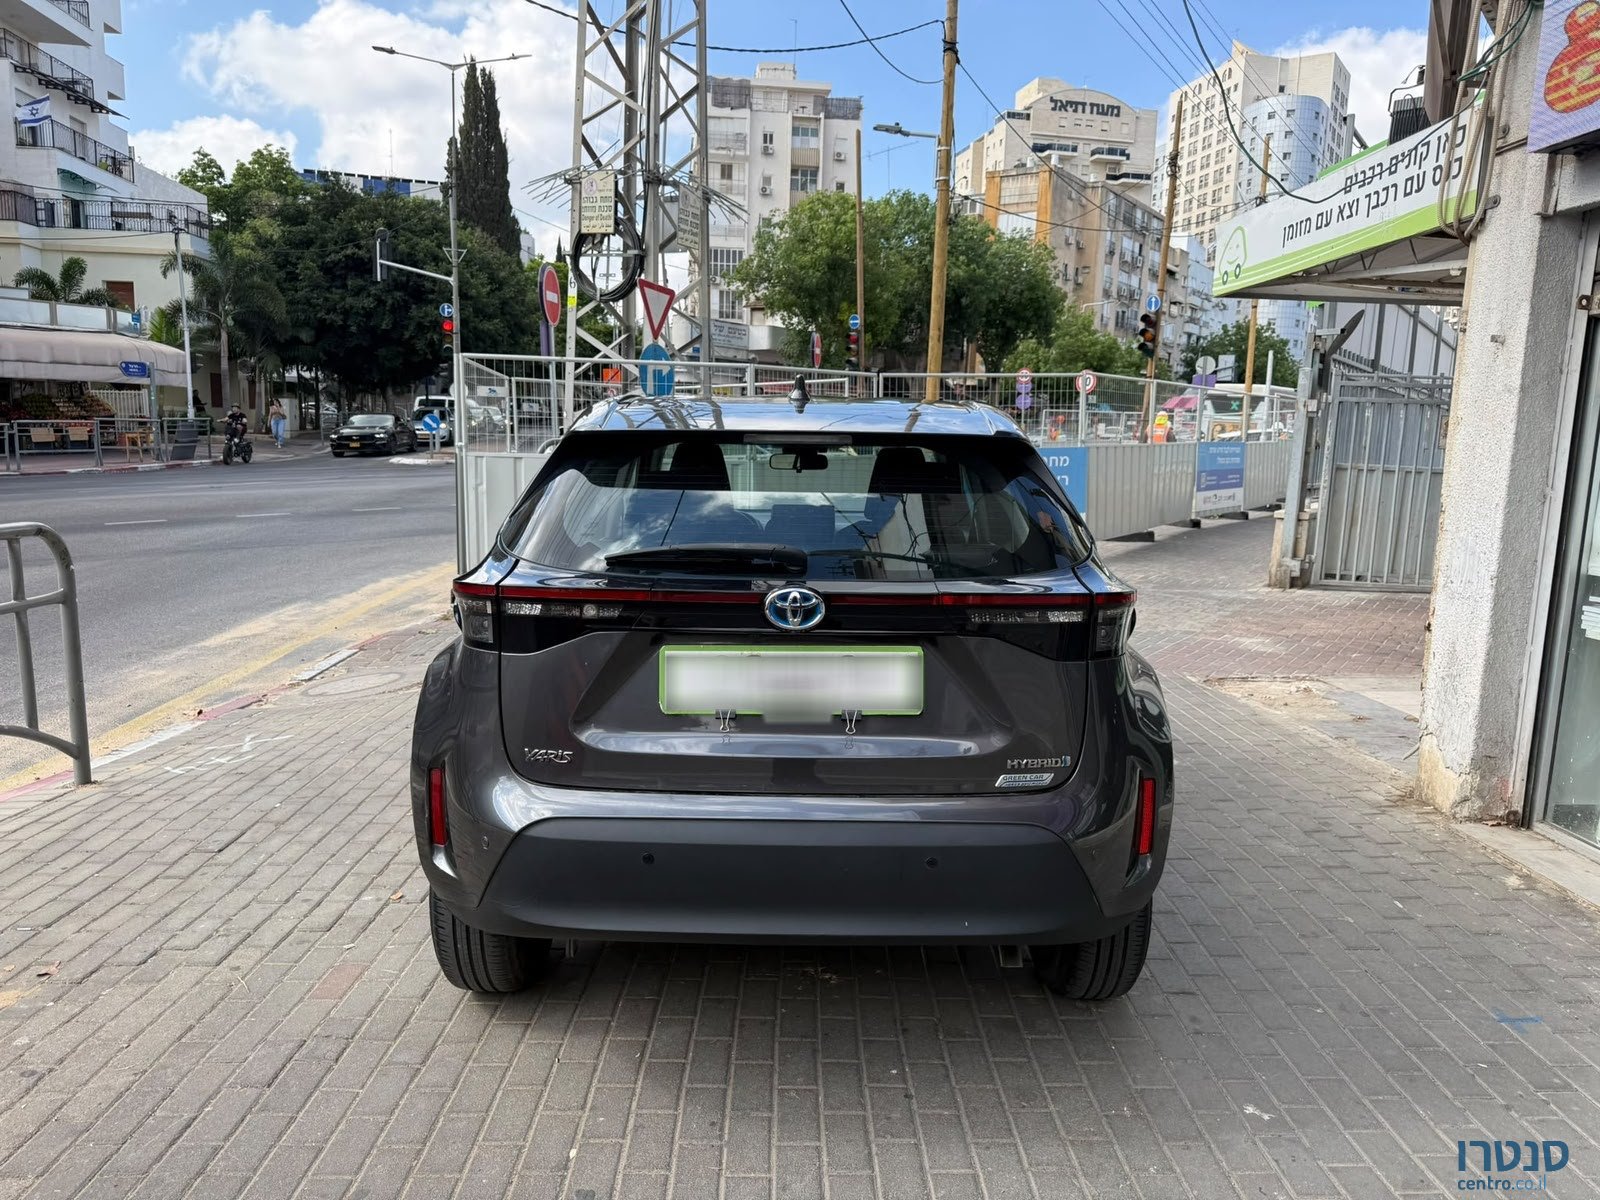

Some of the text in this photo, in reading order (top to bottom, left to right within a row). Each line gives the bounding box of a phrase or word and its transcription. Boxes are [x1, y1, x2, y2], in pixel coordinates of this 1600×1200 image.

[1388, 139, 1431, 177] קונים
[1344, 162, 1384, 195] רכבים
[1282, 155, 1463, 249] כס עם רכבך וצא עם מזומן
[524, 748, 573, 763] YARIS
[1007, 758, 1061, 769] HYBRID
